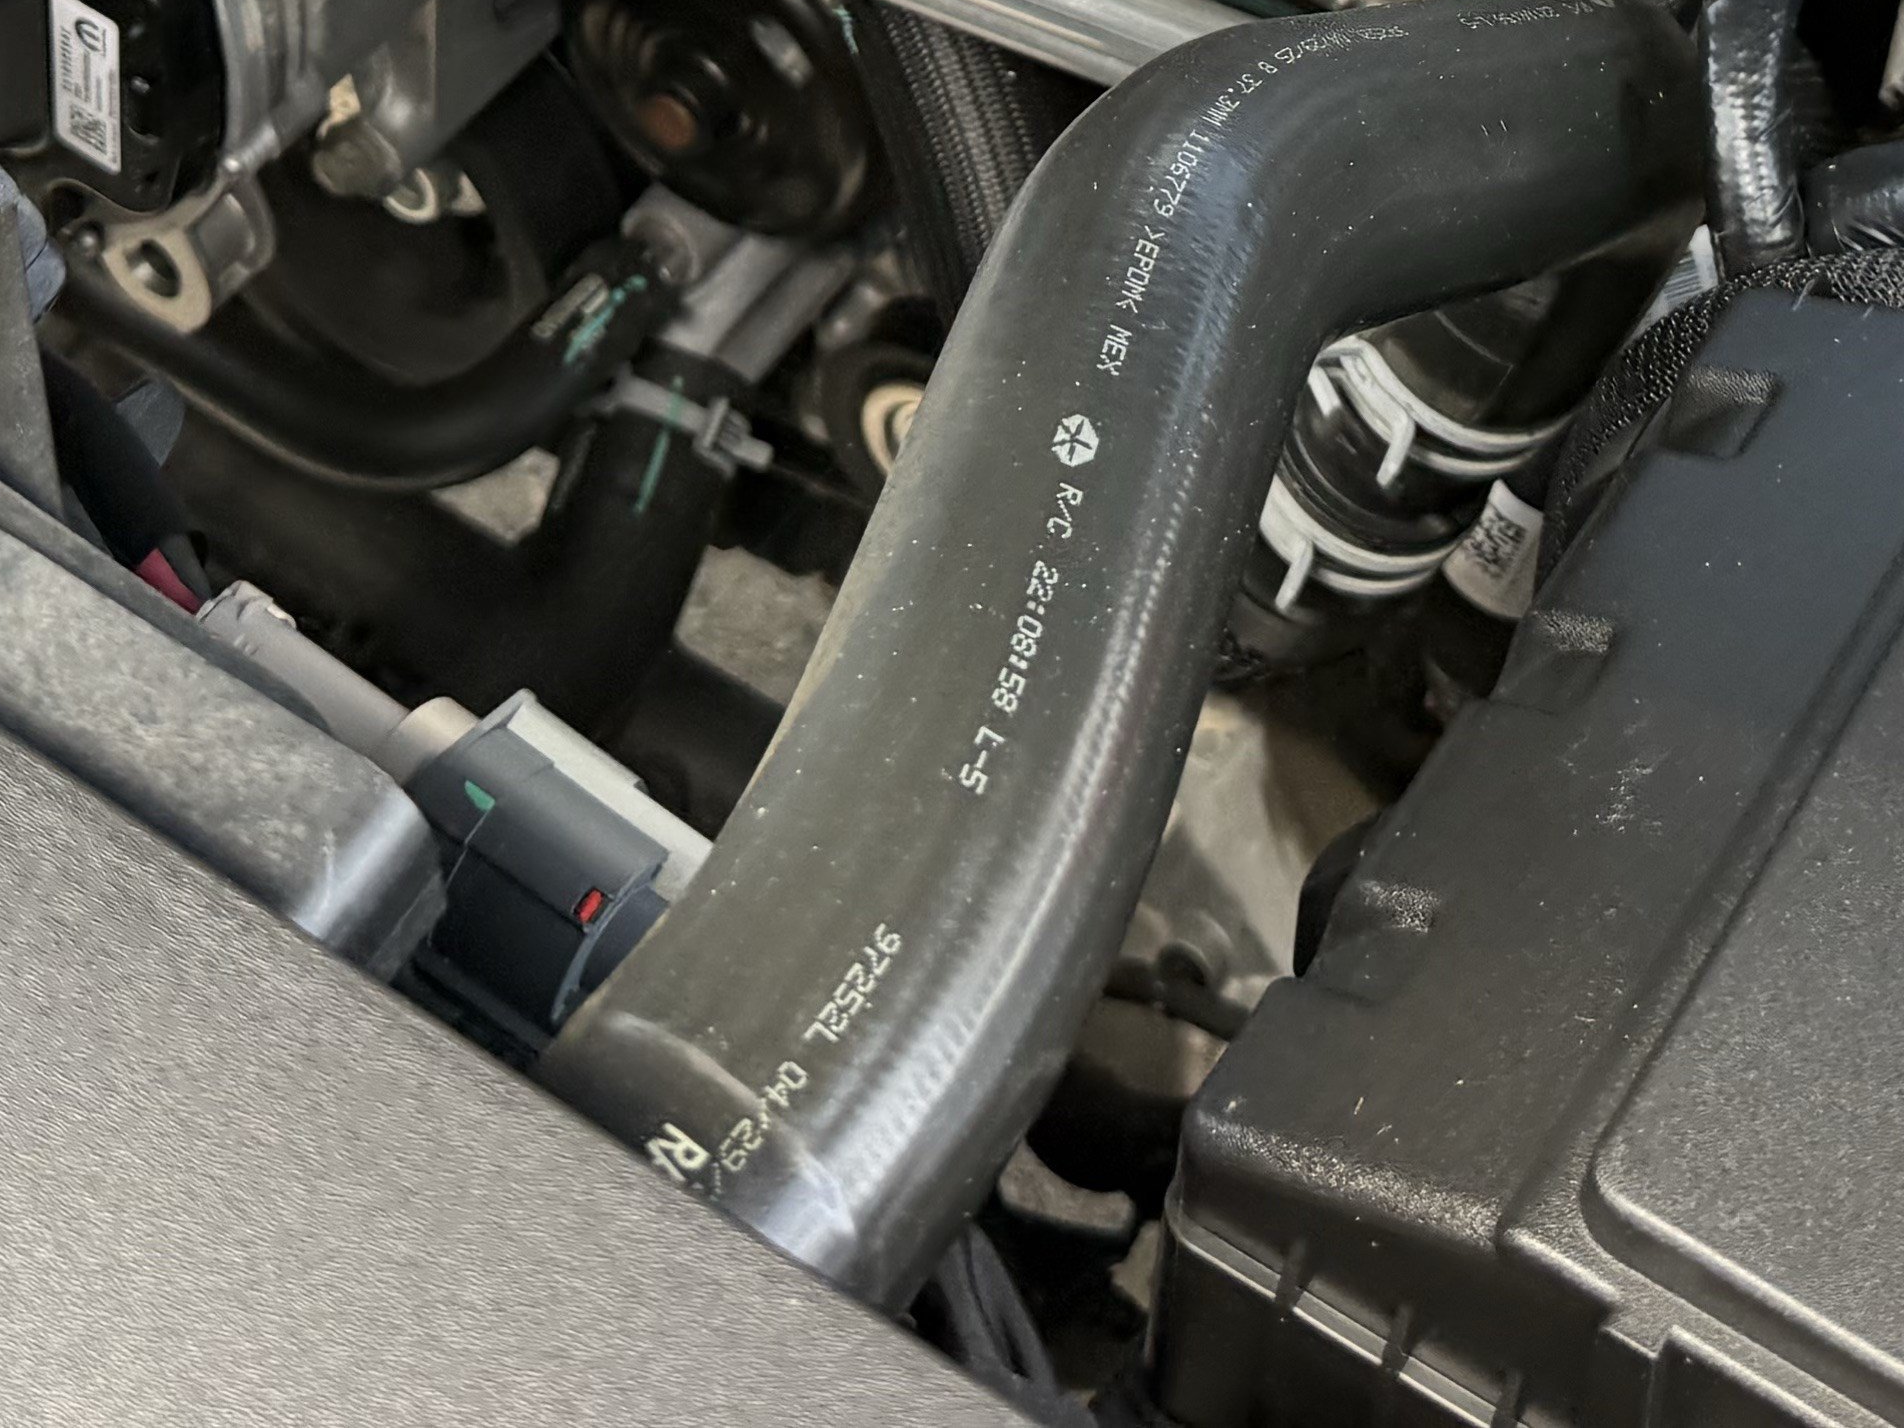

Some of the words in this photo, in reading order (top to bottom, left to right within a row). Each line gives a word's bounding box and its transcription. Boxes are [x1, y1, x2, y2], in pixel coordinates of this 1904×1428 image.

[1153, 129, 1210, 218] 1106779
[1096, 323, 1133, 376] MEX
[1046, 482, 1084, 540] R/C
[991, 559, 1060, 714] 22:08:58
[958, 725, 1006, 794] L-5
[801, 922, 902, 1043] 97252L
